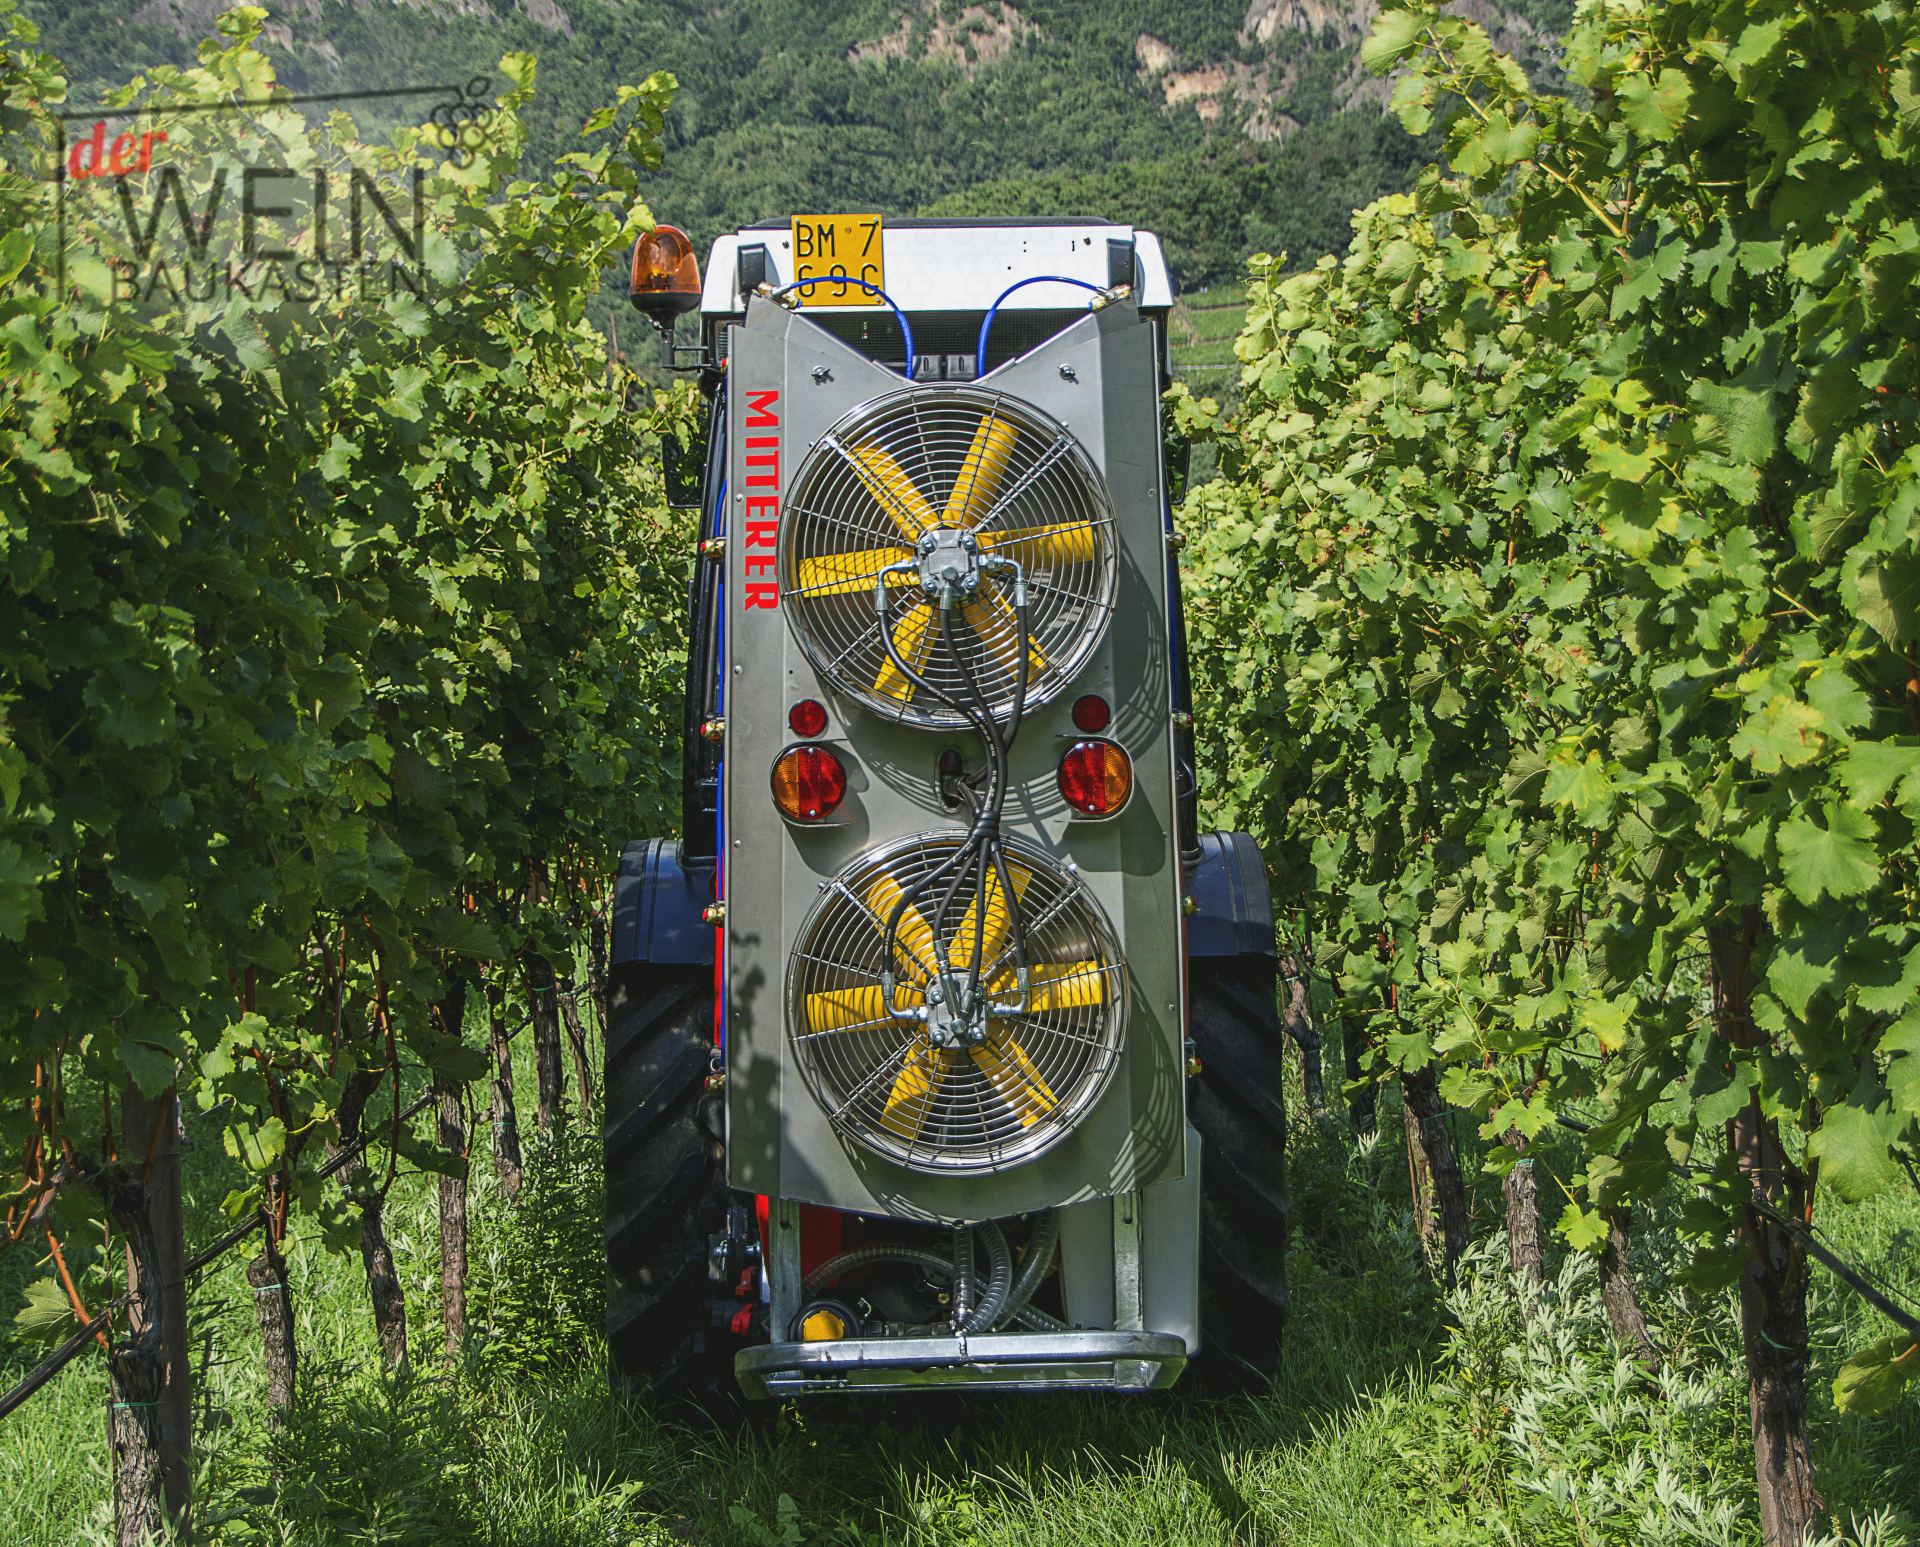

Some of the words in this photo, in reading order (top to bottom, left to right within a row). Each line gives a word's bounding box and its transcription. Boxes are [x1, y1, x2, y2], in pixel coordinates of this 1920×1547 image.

[795, 223, 836, 258] BM
[859, 221, 879, 257] 7
[745, 390, 779, 611] MITTERER
